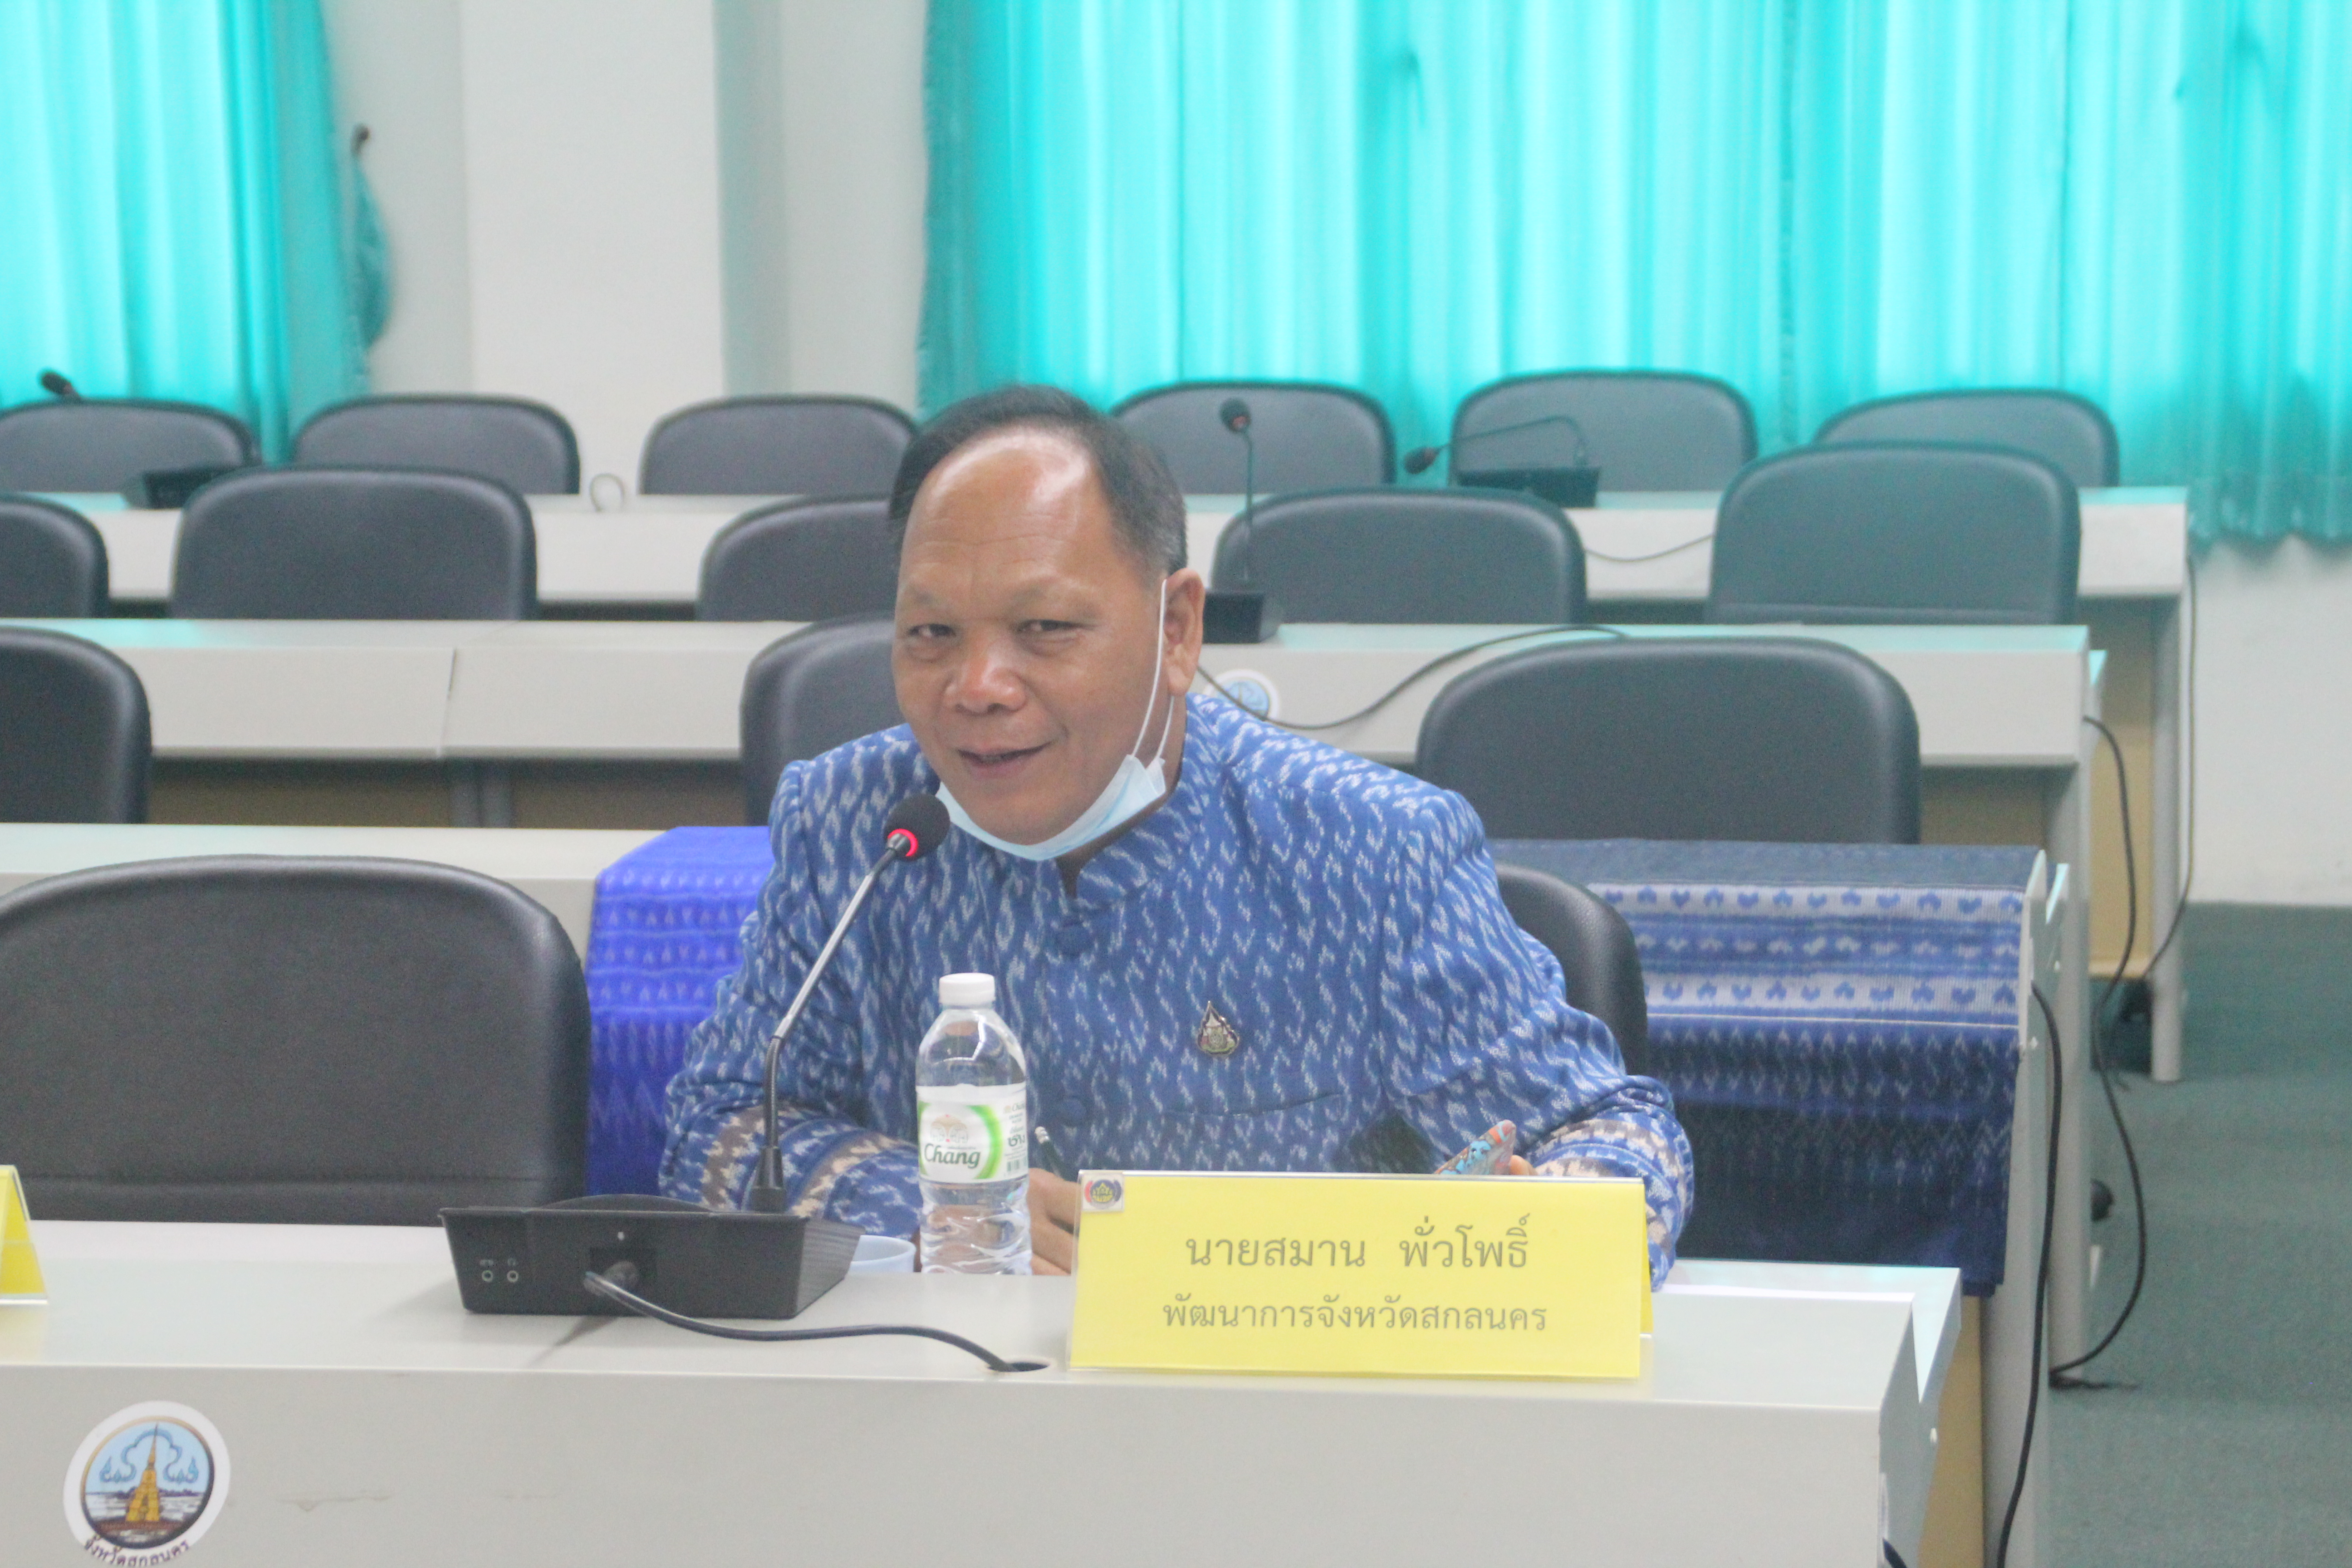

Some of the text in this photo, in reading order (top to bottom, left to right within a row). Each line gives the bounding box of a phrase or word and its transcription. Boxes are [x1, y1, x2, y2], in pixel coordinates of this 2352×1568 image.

[924, 1143, 981, 1169] Chang
[1185, 1212, 1530, 1268] นายสมาน พั่วโพธิ์
[1162, 1292, 1548, 1331] พัฒนาการจังหวัดสกลนคร
